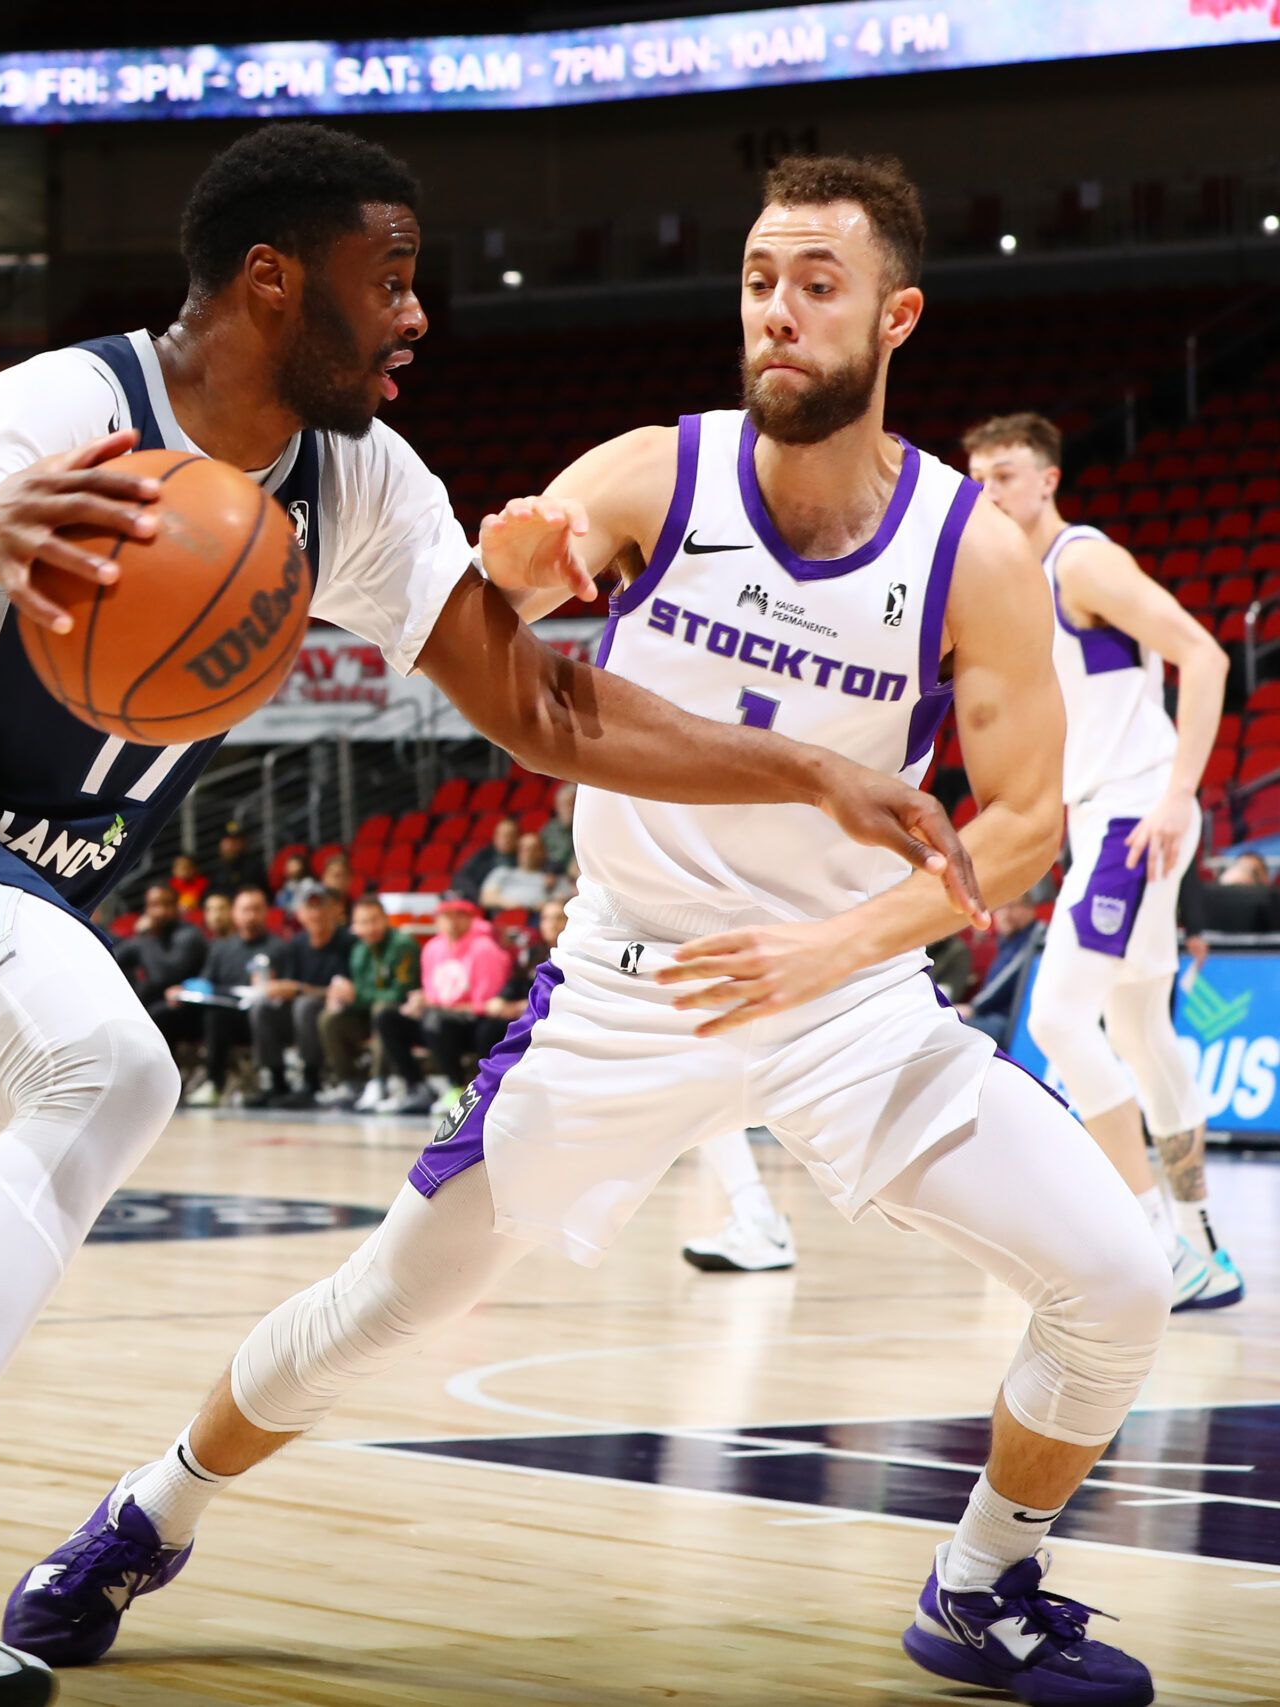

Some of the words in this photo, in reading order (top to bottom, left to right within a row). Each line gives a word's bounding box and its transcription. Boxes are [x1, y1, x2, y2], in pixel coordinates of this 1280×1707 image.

[30, 64, 109, 106] FRI:
[117, 64, 204, 103] 3PM
[235, 60, 324, 99] 9PM
[334, 55, 421, 95] SAT:
[429, 53, 521, 92] 9AM
[550, 45, 626, 86] 7PM
[632, 37, 721, 79] SUN:
[727, 26, 826, 69] 10AM
[856, 18, 882, 56] 4
[890, 12, 950, 55] PM
[647, 597, 908, 702] STOCKTON
[773, 599, 806, 616] KAISER
